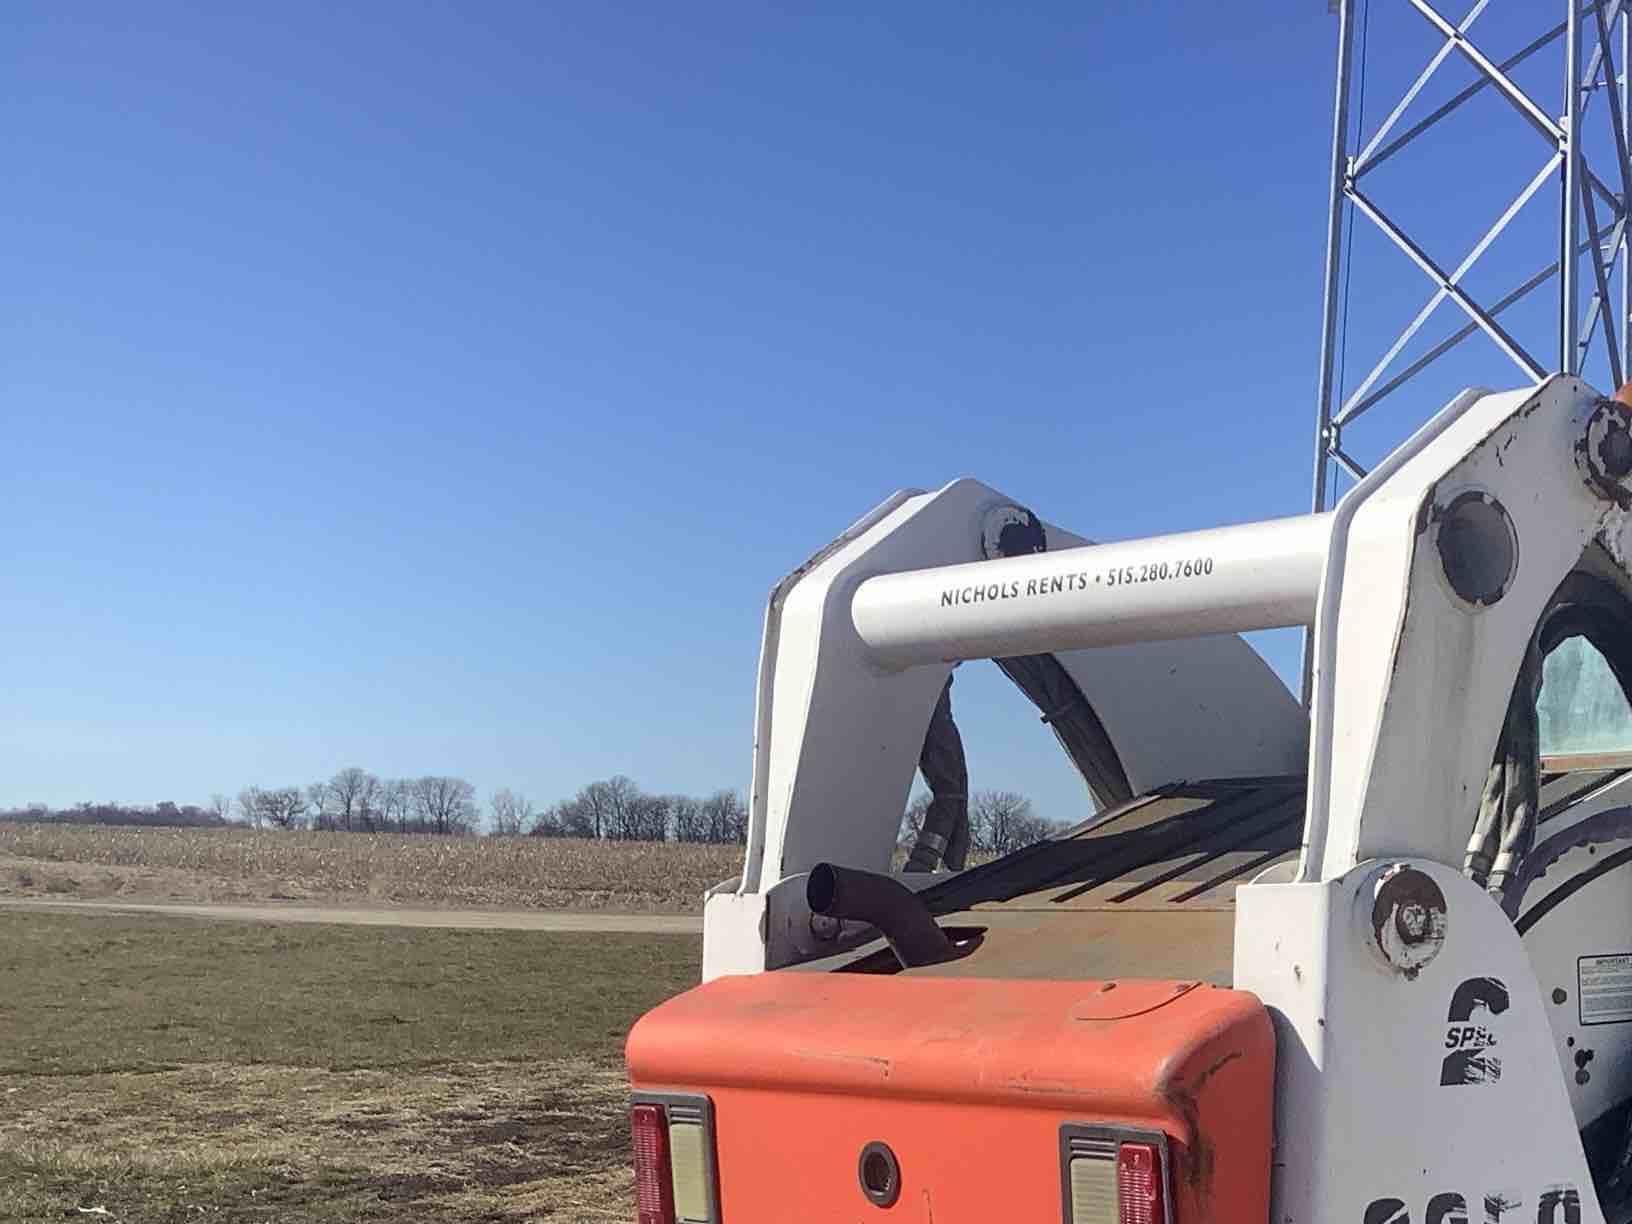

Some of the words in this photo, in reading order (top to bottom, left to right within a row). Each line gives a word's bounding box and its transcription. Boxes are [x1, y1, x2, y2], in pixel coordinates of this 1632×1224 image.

[941, 580, 1020, 607] NICHOLS
[1026, 572, 1088, 596] RENTS
[1106, 557, 1213, 586] 515.280.7600
